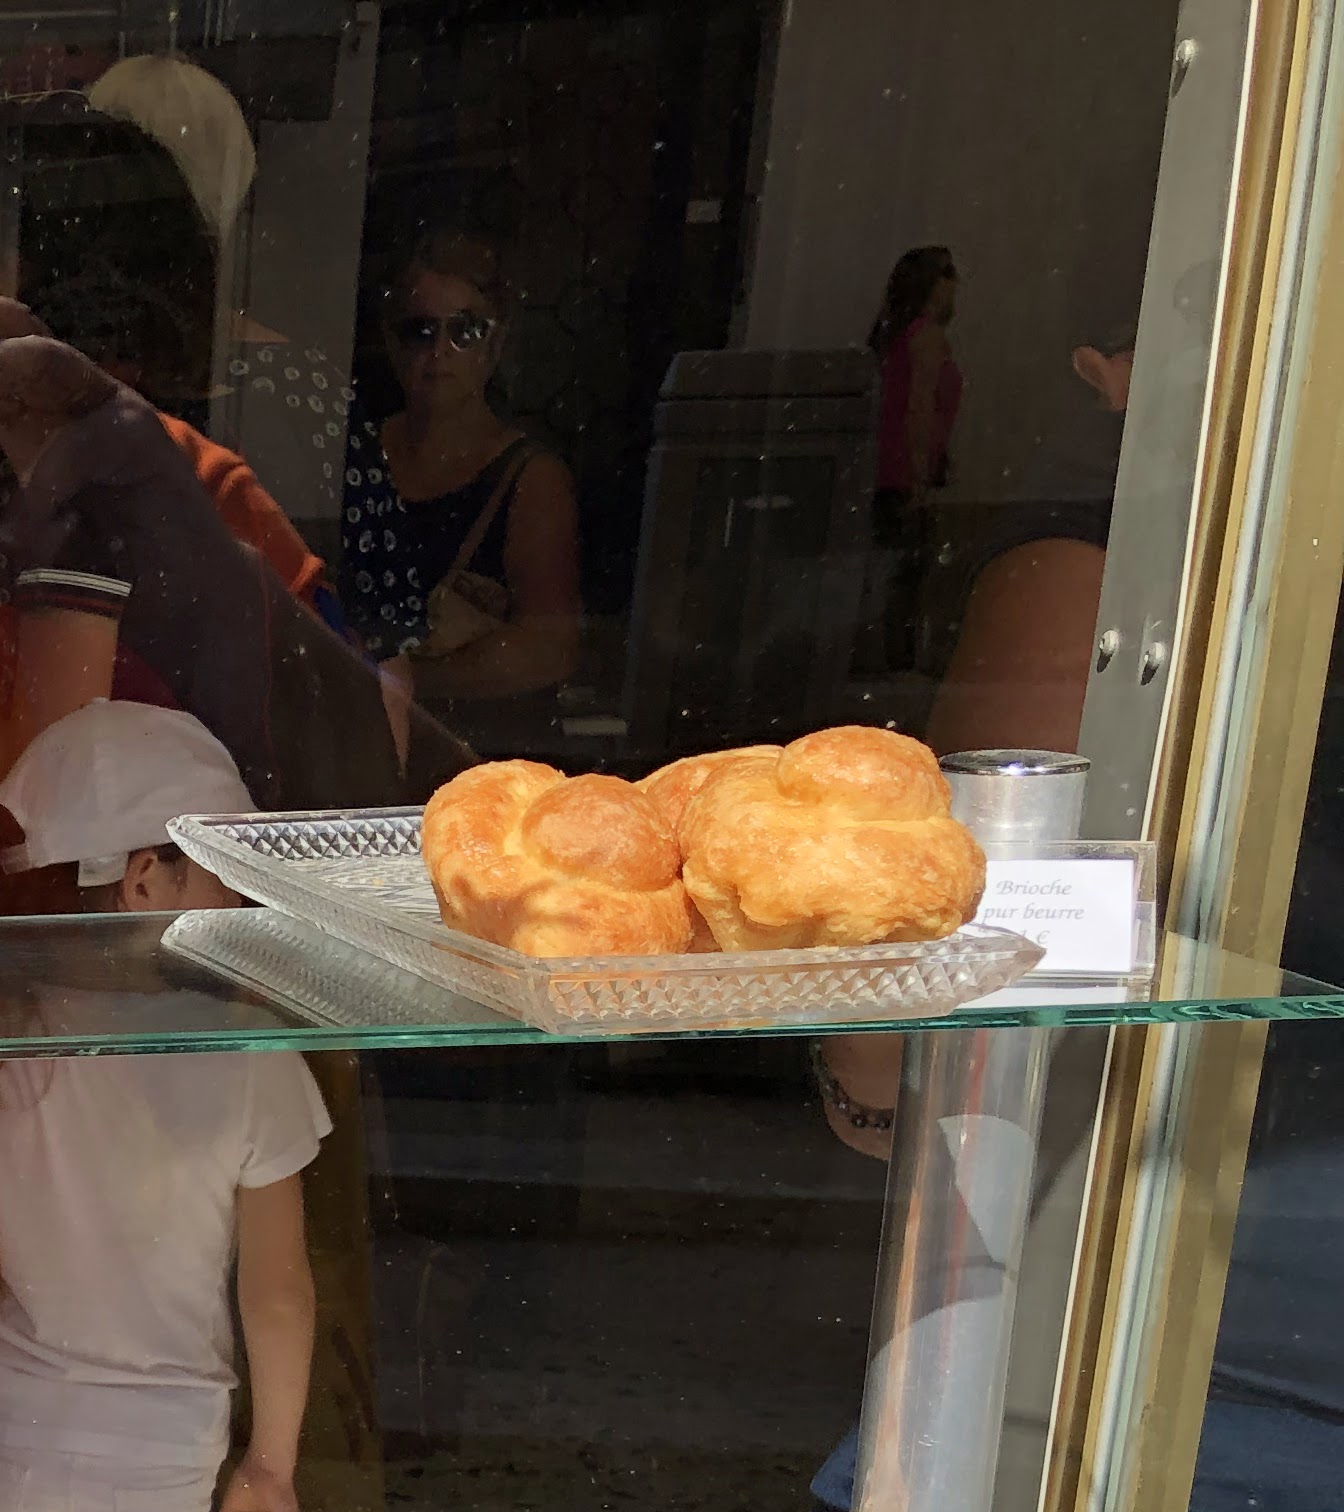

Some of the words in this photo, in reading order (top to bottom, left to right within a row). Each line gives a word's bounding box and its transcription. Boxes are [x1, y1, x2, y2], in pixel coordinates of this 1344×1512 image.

[996, 879, 1072, 896] Brioche
[983, 906, 1019, 928] pur
[1022, 903, 1085, 920] beurre
[1036, 930, 1051, 945] €
